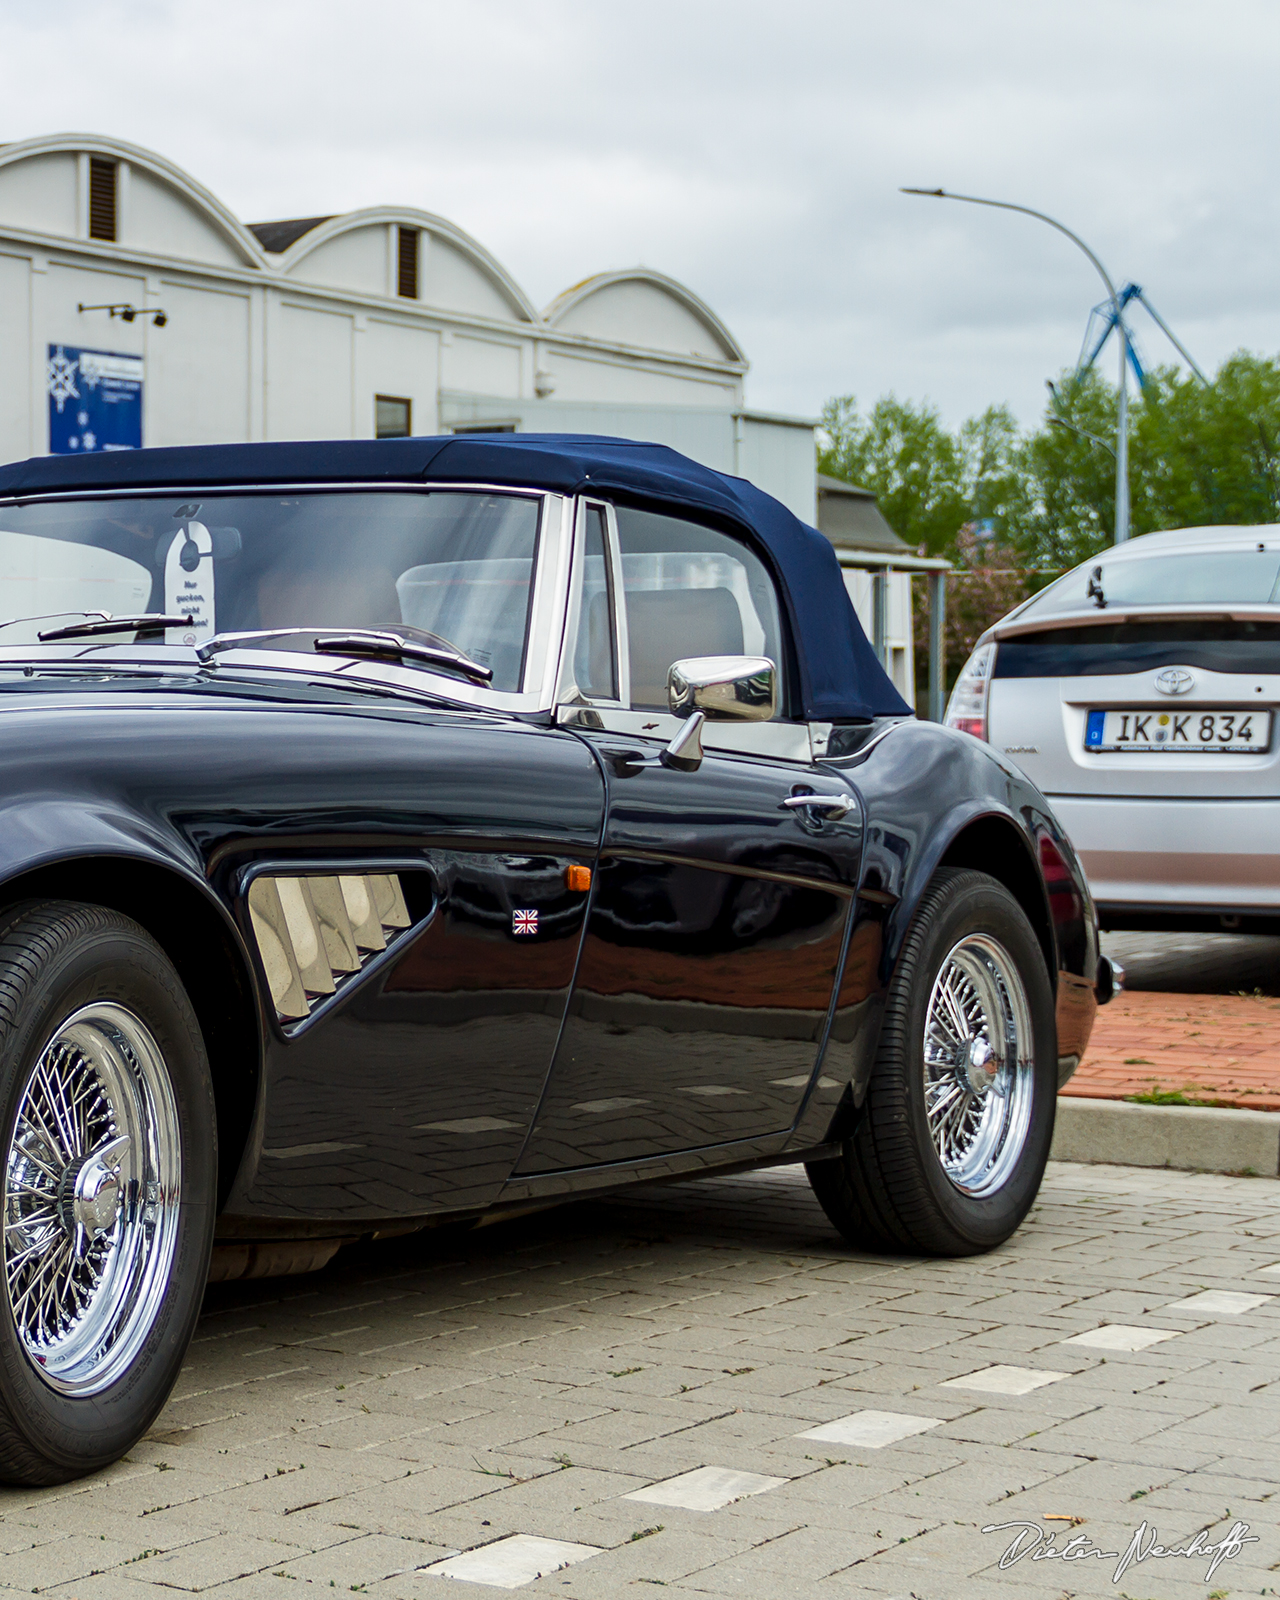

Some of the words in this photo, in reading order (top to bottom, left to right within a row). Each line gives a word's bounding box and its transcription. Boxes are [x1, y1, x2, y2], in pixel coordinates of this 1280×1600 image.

[184, 580, 197, 589] Nur
[181, 606, 200, 615] nicht
[1116, 715, 1153, 742] IK
[1172, 715, 1191, 742] K
[1199, 715, 1253, 742] 834
